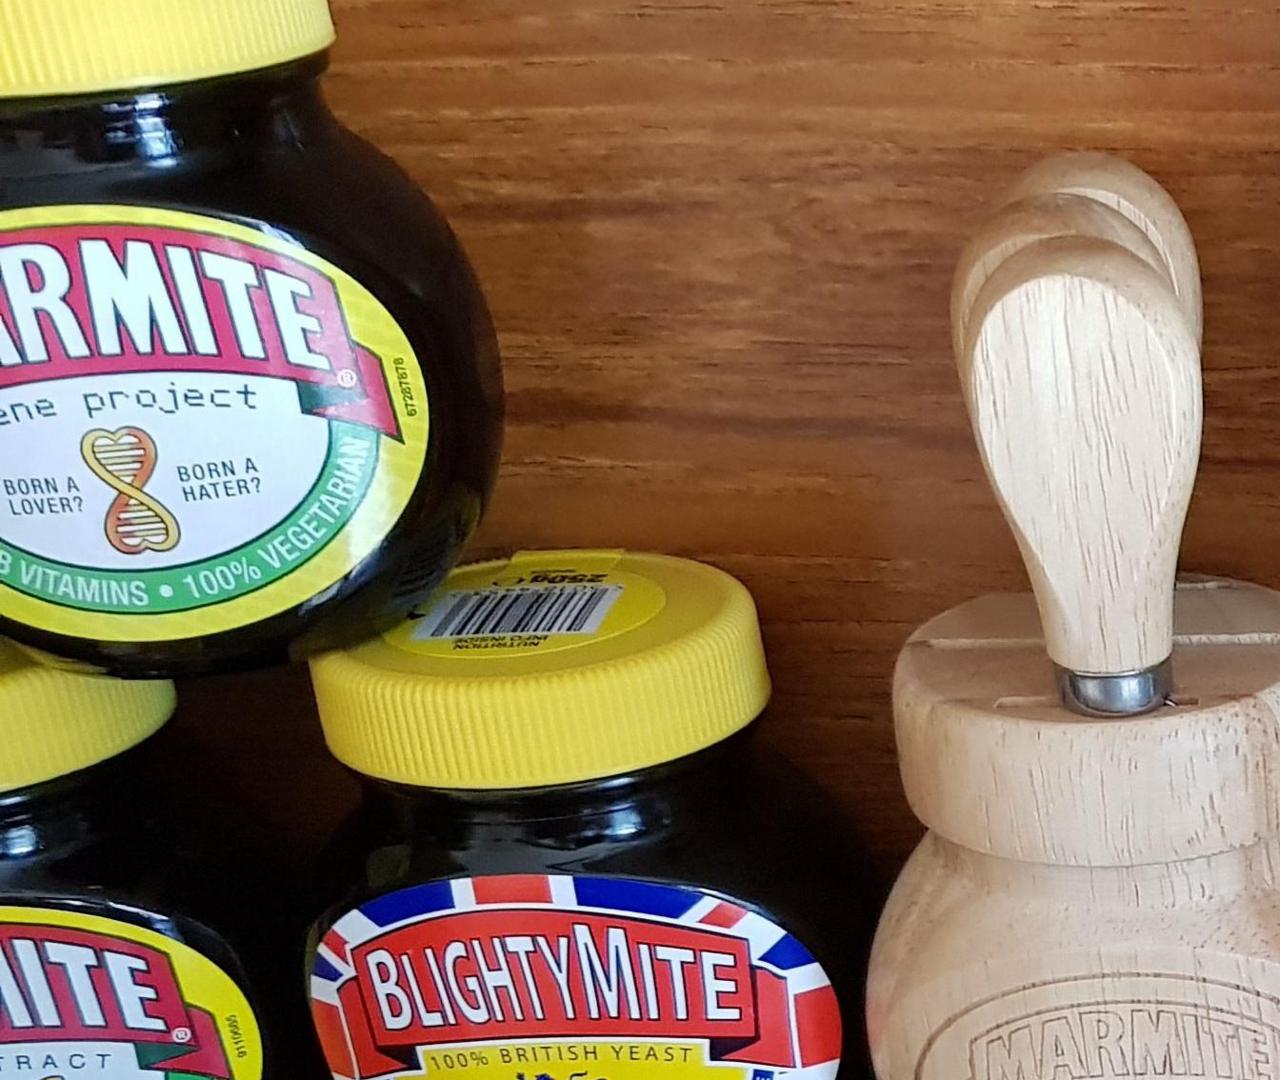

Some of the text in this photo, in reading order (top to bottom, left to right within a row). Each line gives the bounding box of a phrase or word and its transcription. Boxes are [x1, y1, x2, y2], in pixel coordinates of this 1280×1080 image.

[82, 382, 258, 418] project
[177, 457, 259, 484] BORN A
[3, 477, 80, 497] BORN A
[182, 476, 261, 502] HATER?
[9, 495, 84, 516] LOVER?
[20, 559, 150, 606] VITAMINS
[183, 560, 262, 599] 100%
[259, 436, 372, 569] VEGETARIAN
[366, 922, 741, 1031] BLIGHTYMITE
[430, 1045, 694, 1071] 100% BRITISH YEAST
